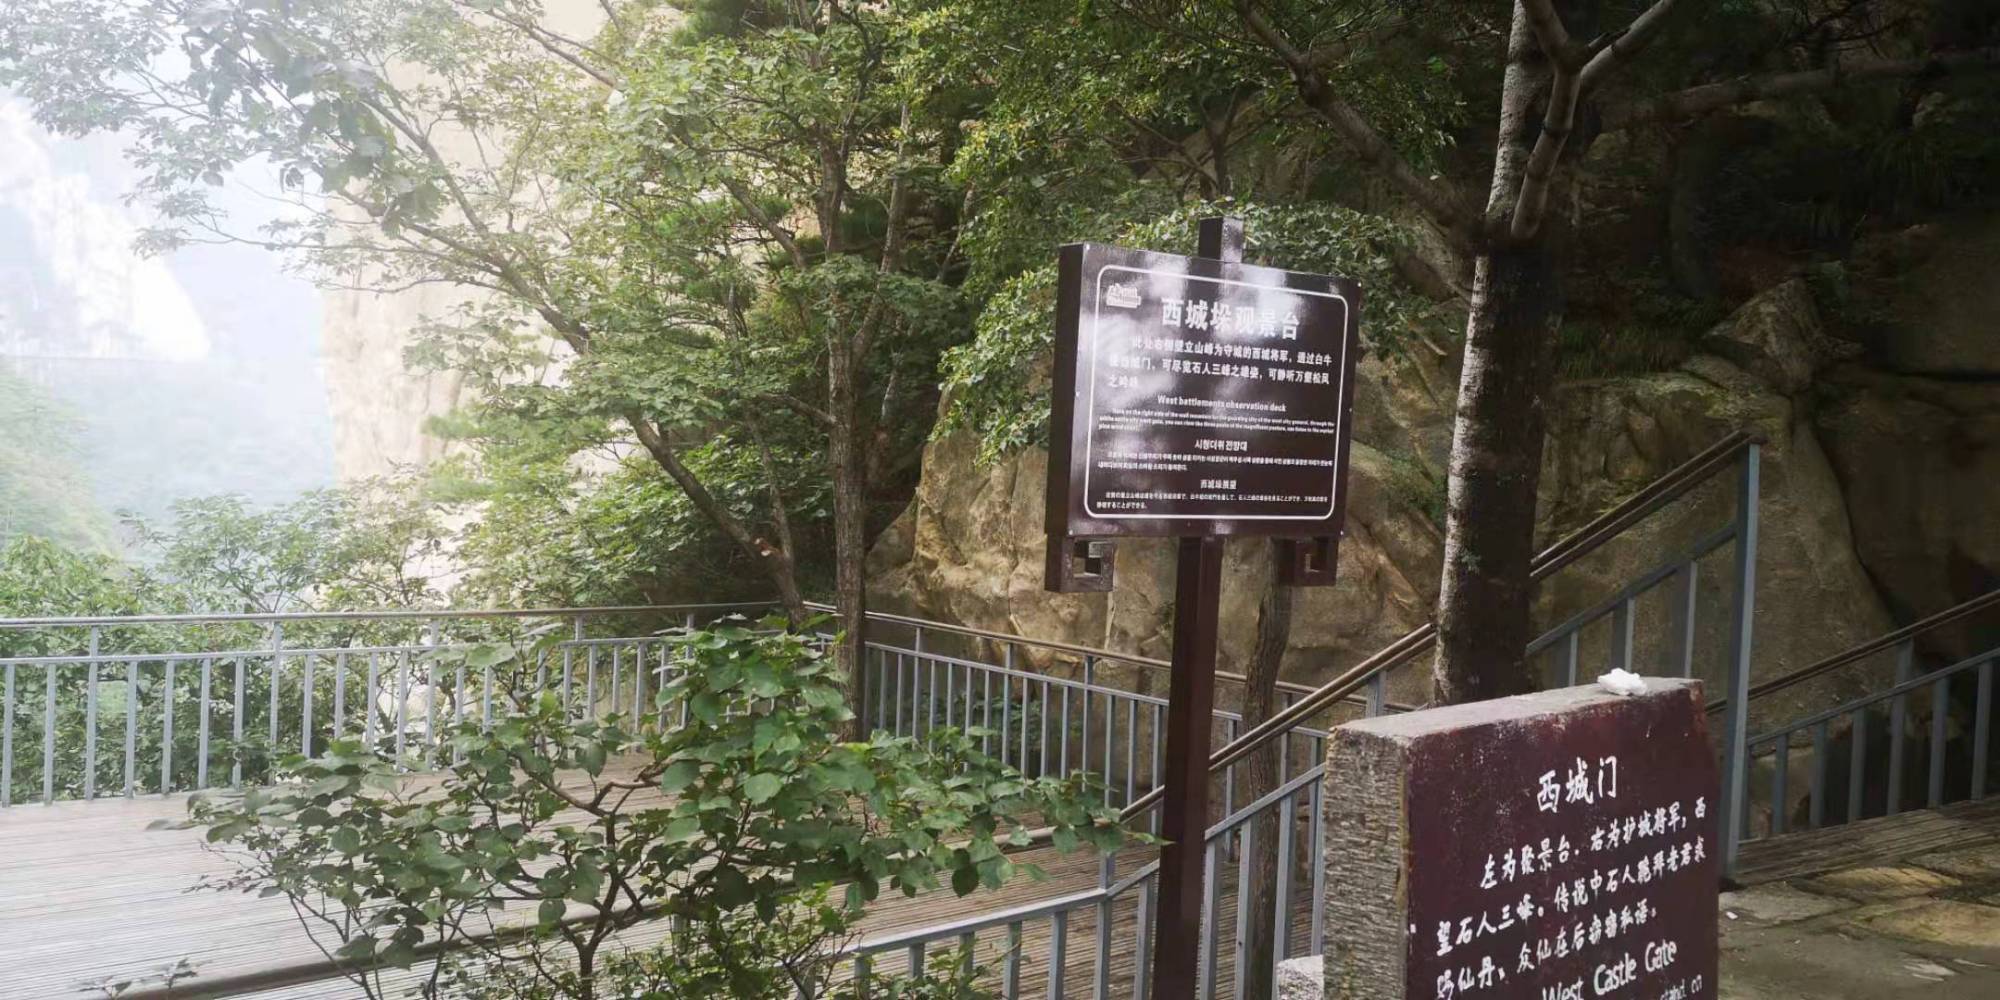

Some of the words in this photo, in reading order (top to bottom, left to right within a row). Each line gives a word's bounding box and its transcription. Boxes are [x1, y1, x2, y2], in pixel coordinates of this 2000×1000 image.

[1161, 297, 1300, 340] 西城垛观景台
[1157, 395, 1178, 405] West
[1179, 396, 1225, 408] battlements
[1226, 400, 1269, 411] observation
[1270, 403, 1287, 412] deck
[1537, 757, 1618, 814] 西城门
[1542, 976, 1585, 1000] West
[1593, 952, 1637, 996] Castle
[1644, 938, 1678, 973] Gate
